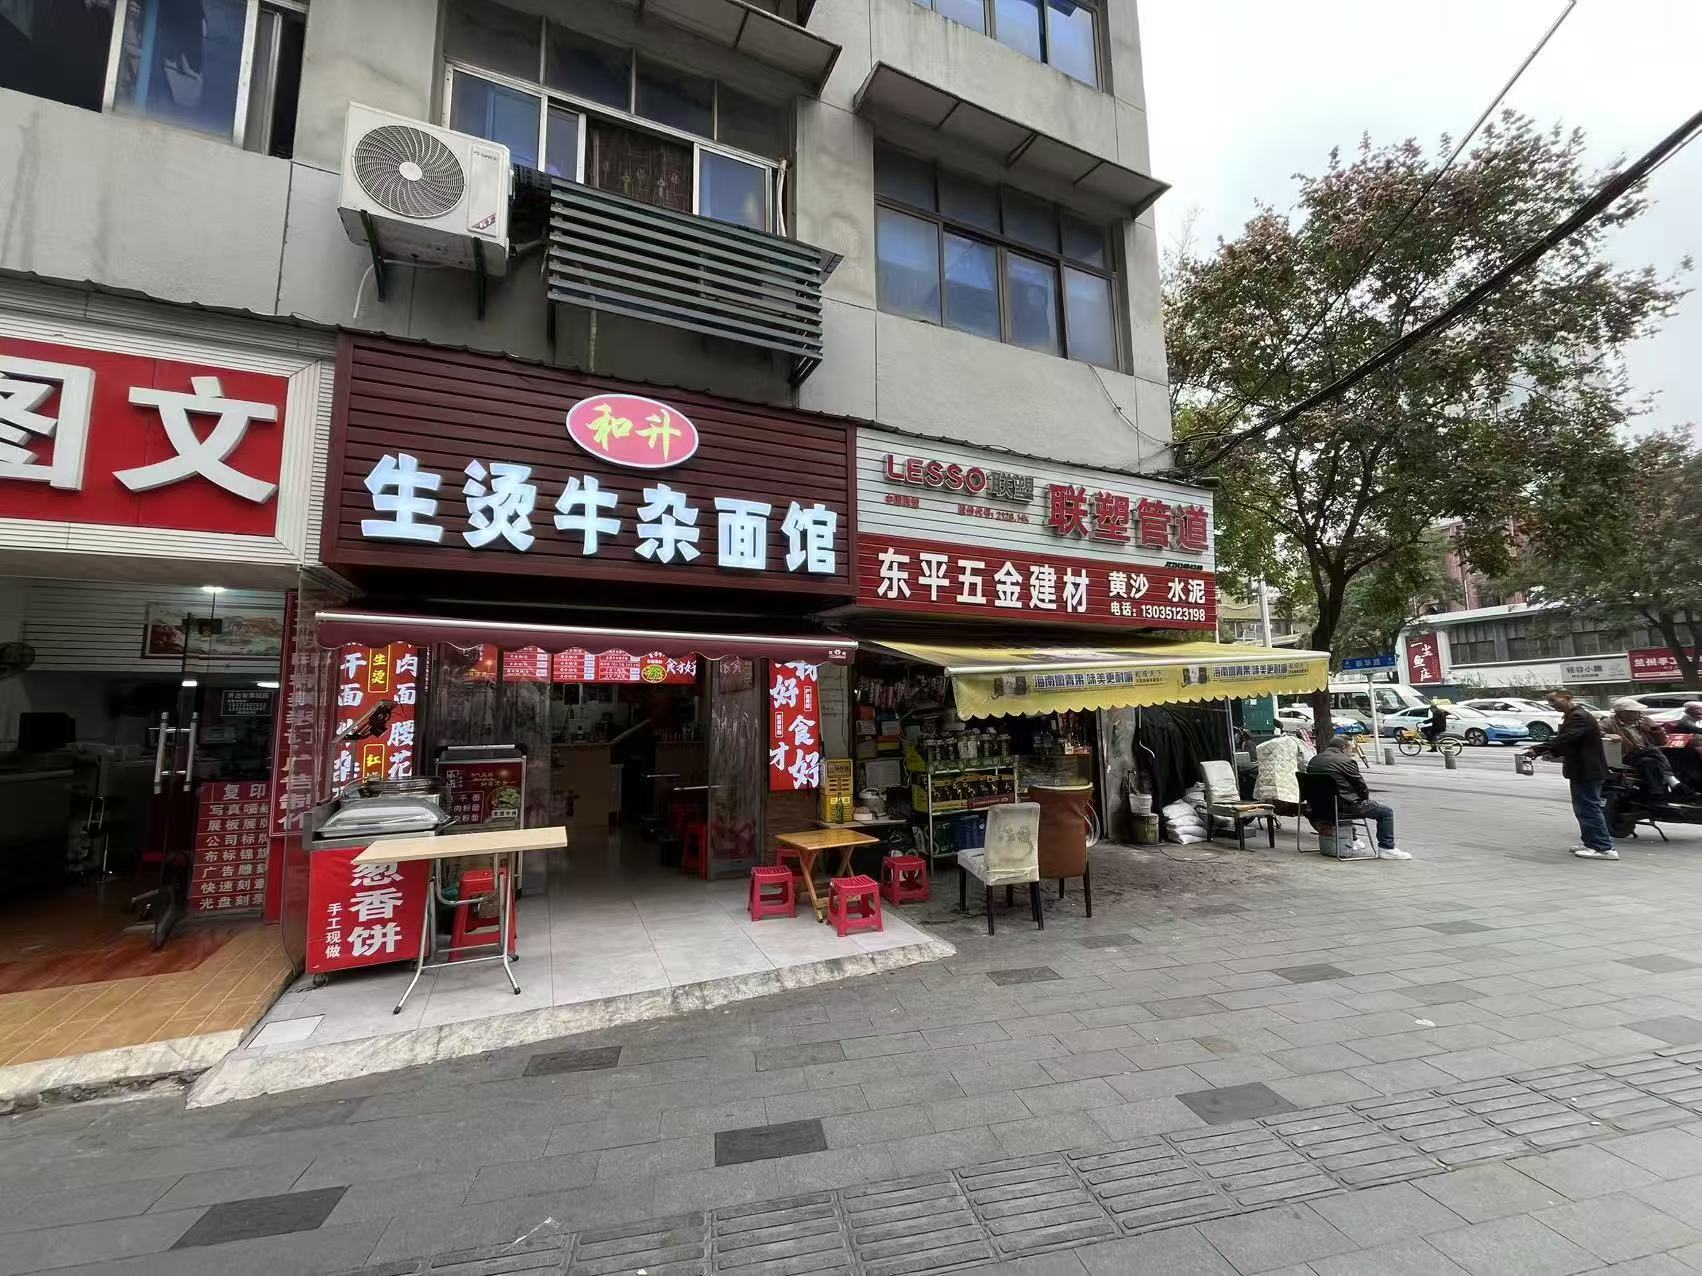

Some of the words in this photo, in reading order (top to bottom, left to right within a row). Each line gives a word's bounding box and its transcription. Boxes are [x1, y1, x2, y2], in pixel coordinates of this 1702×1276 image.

[585, 402, 682, 463] 和升
[884, 454, 988, 494] LESSO
[361, 453, 838, 576] 生烫牛杂面馆
[1046, 484, 1209, 552] 联塑管道
[876, 547, 1090, 614] 东平五金建材
[1108, 571, 1149, 600] 黄沙
[1167, 577, 1206, 604] 水泥
[370, 653, 387, 684] 生烫
[222, 783, 267, 800] 复印
[325, 902, 342, 959] 手工现做
[347, 861, 404, 957] 葱香饼
